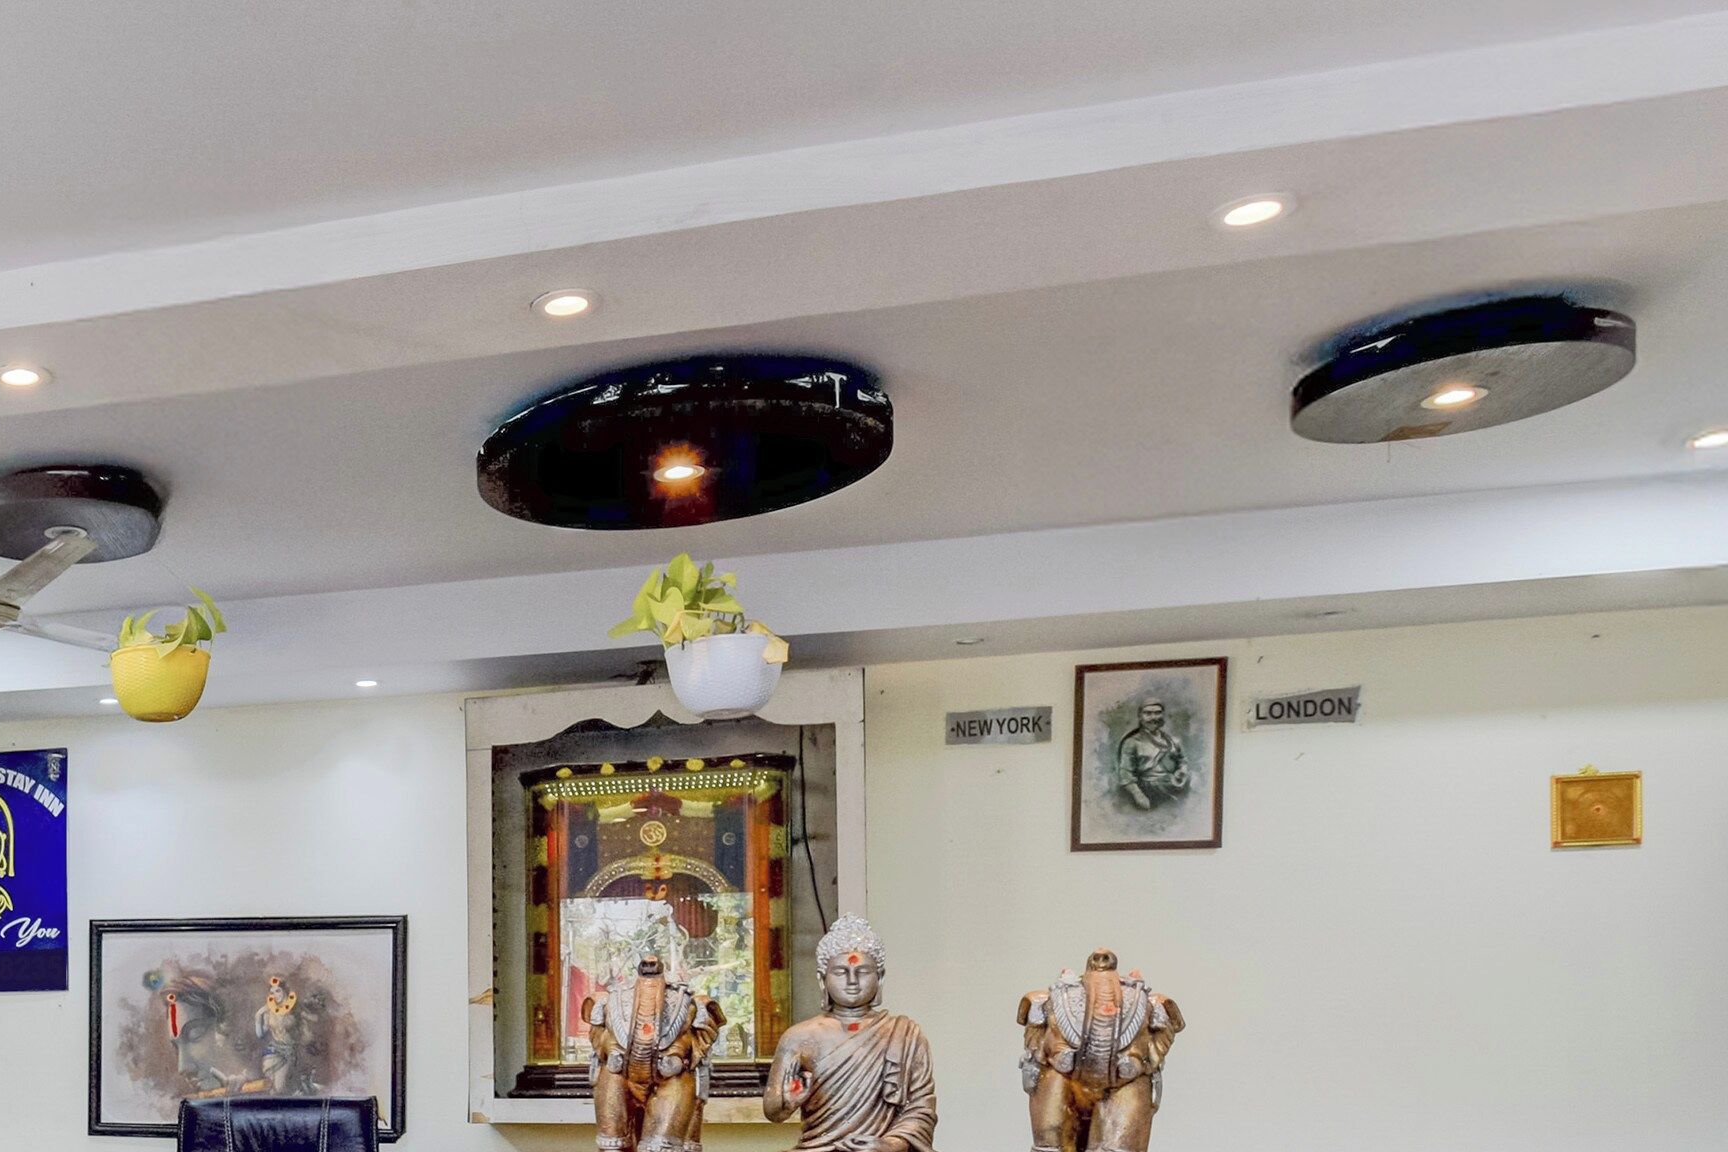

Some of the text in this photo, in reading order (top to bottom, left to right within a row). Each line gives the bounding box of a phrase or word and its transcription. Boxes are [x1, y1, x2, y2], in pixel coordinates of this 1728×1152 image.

[1255, 696, 1353, 722] LONDON
[33, 783, 65, 818] INN
[0, 916, 61, 948] You
